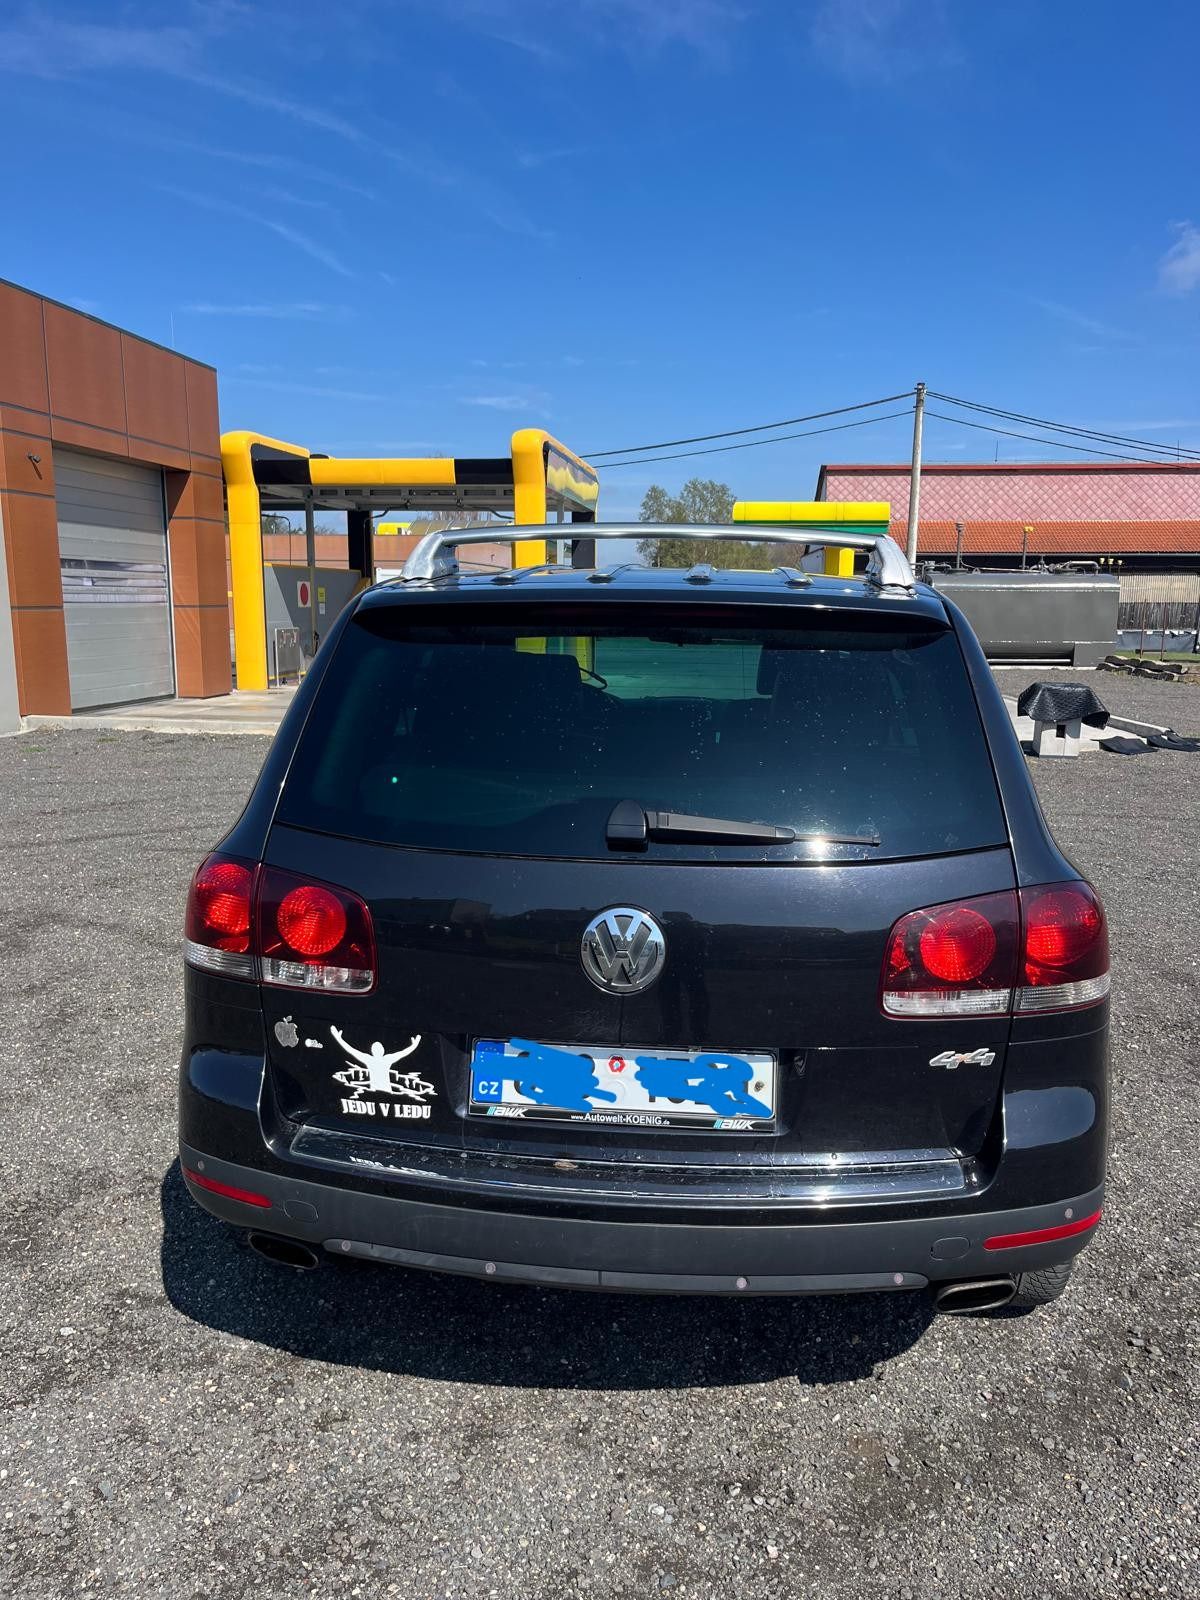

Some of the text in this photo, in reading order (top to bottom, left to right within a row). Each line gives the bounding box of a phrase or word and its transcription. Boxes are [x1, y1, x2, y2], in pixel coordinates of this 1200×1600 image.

[929, 1048, 996, 1069] 4x4
[478, 1080, 499, 1095] CZ
[340, 1098, 432, 1119] JEDU V LEDU
[571, 1112, 671, 1126] www.Autowelt-KOENIG.de
